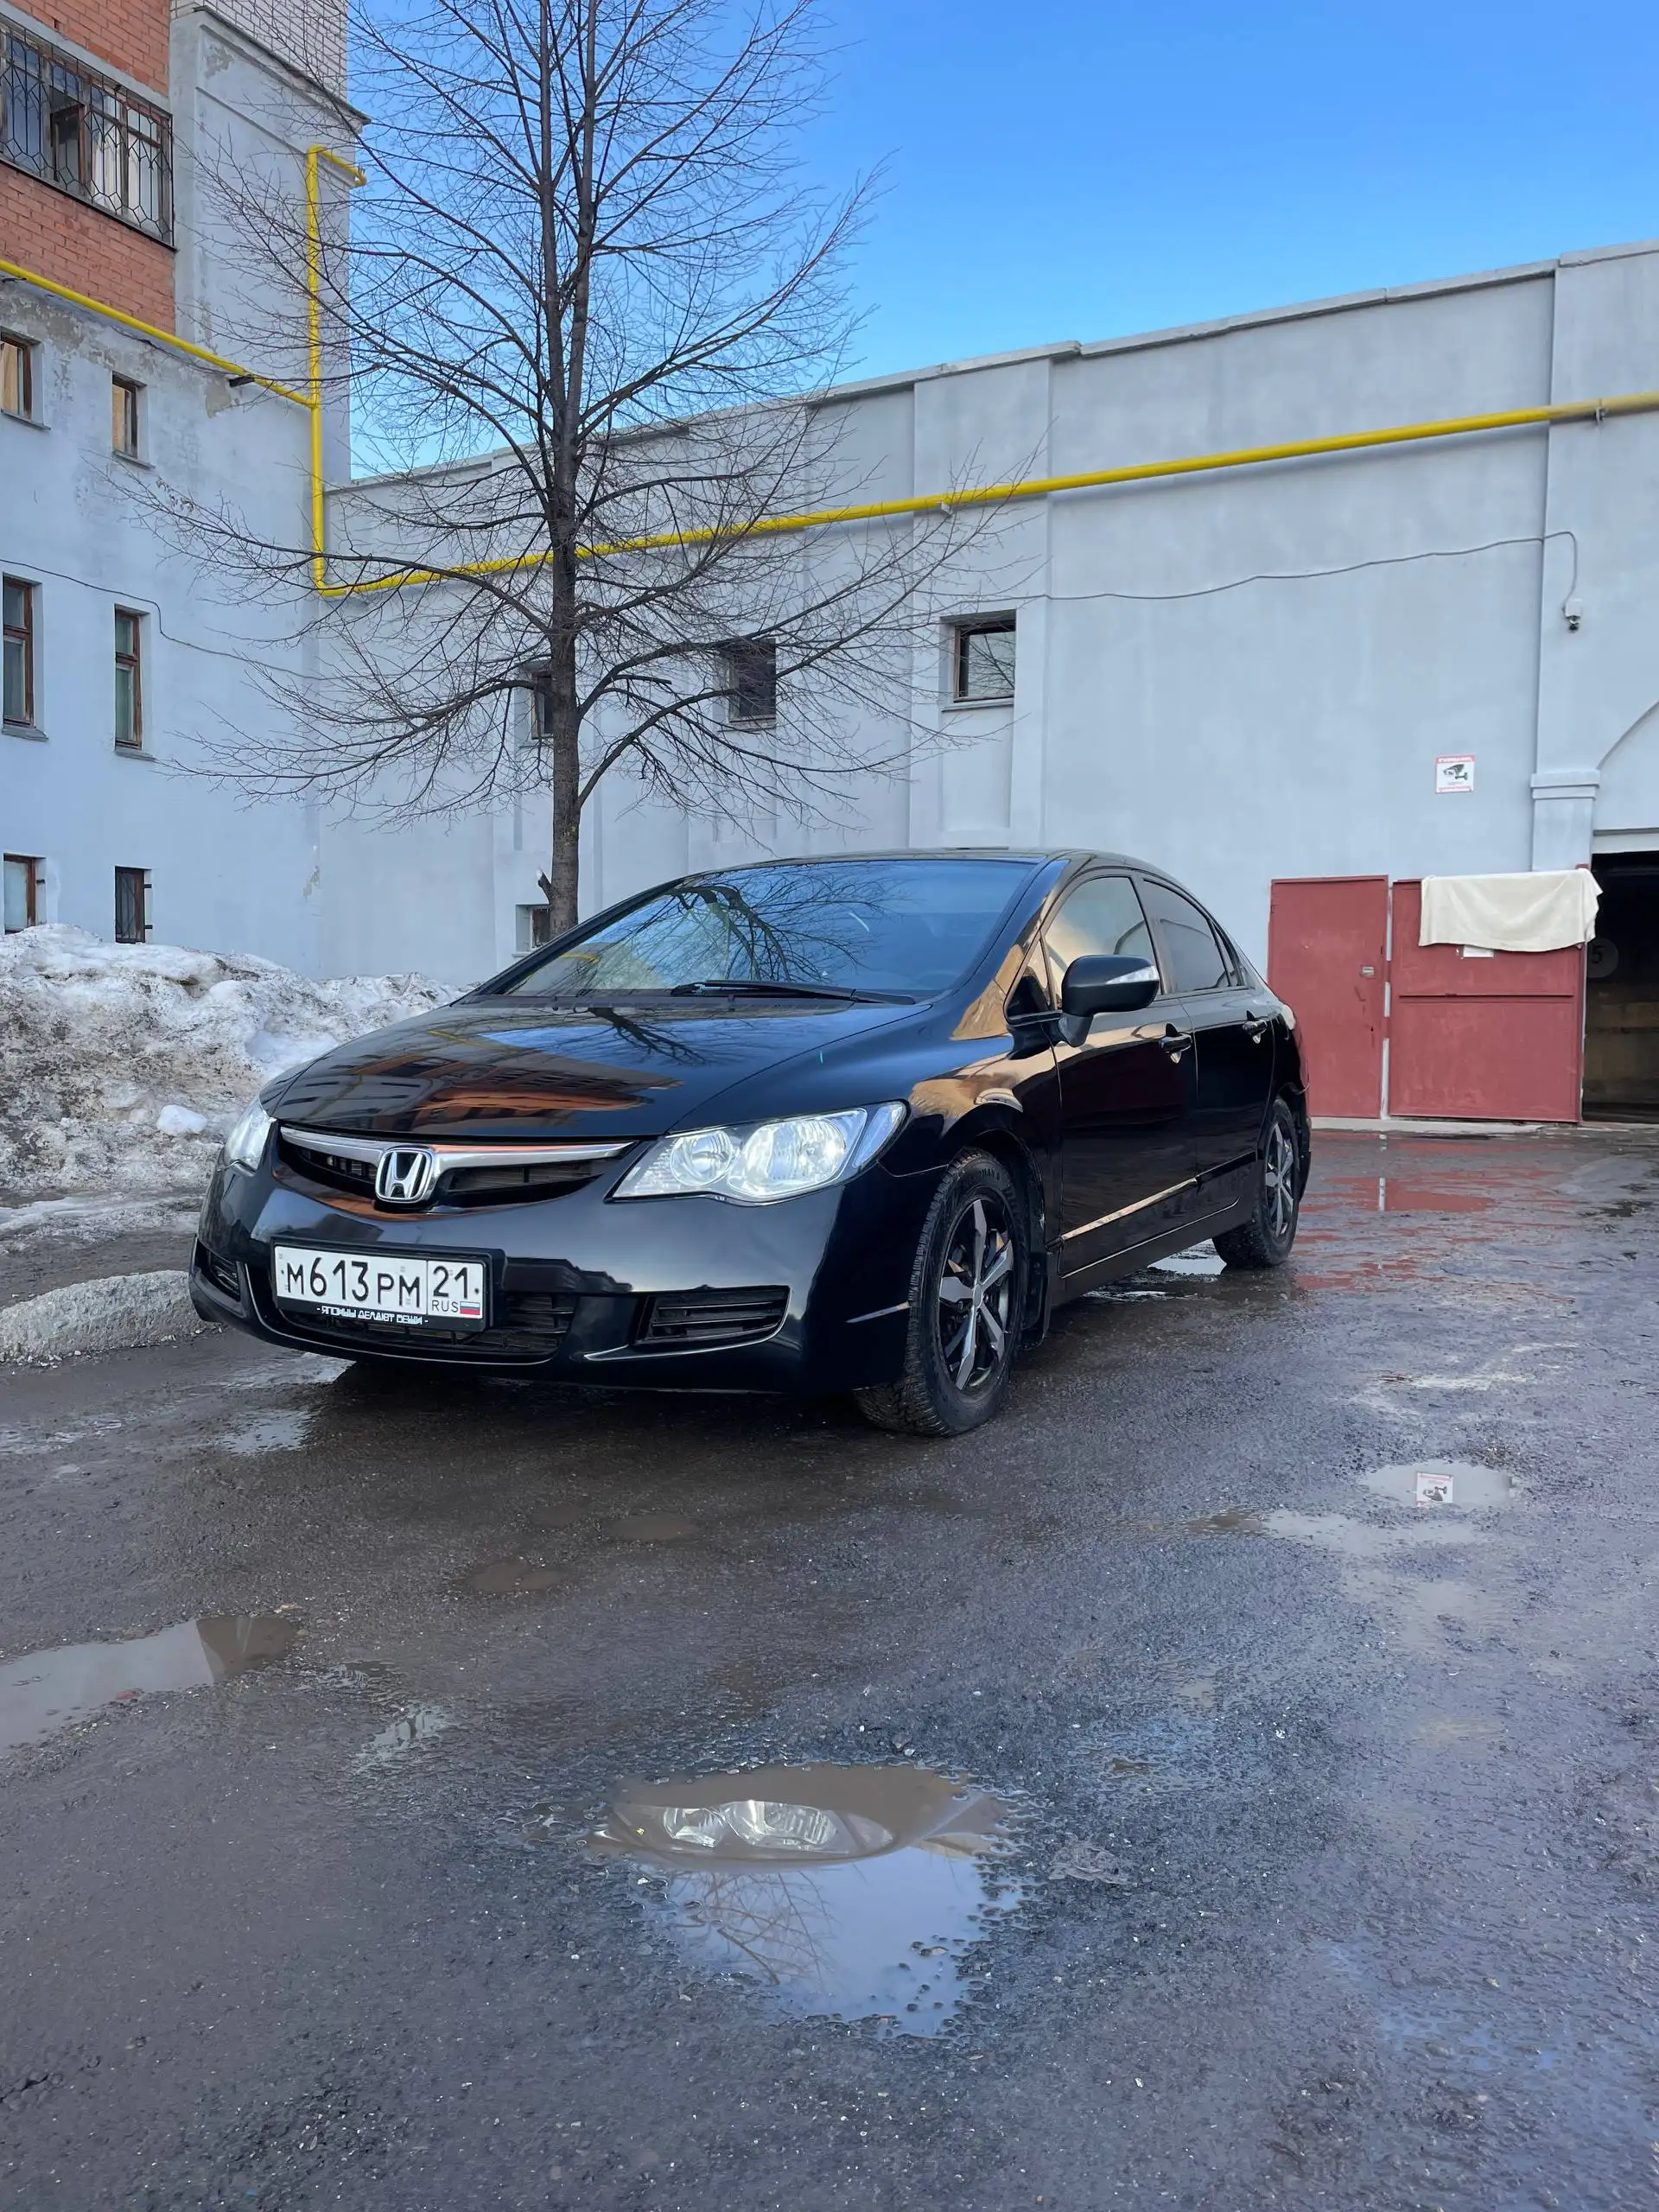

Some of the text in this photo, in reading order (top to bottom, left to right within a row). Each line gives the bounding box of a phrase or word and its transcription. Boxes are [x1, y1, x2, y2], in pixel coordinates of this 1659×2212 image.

[433, 1266, 468, 1300] 21
[431, 1300, 459, 1313] RUS
[358, 1310, 395, 1322] ДЕЛАЮТ
